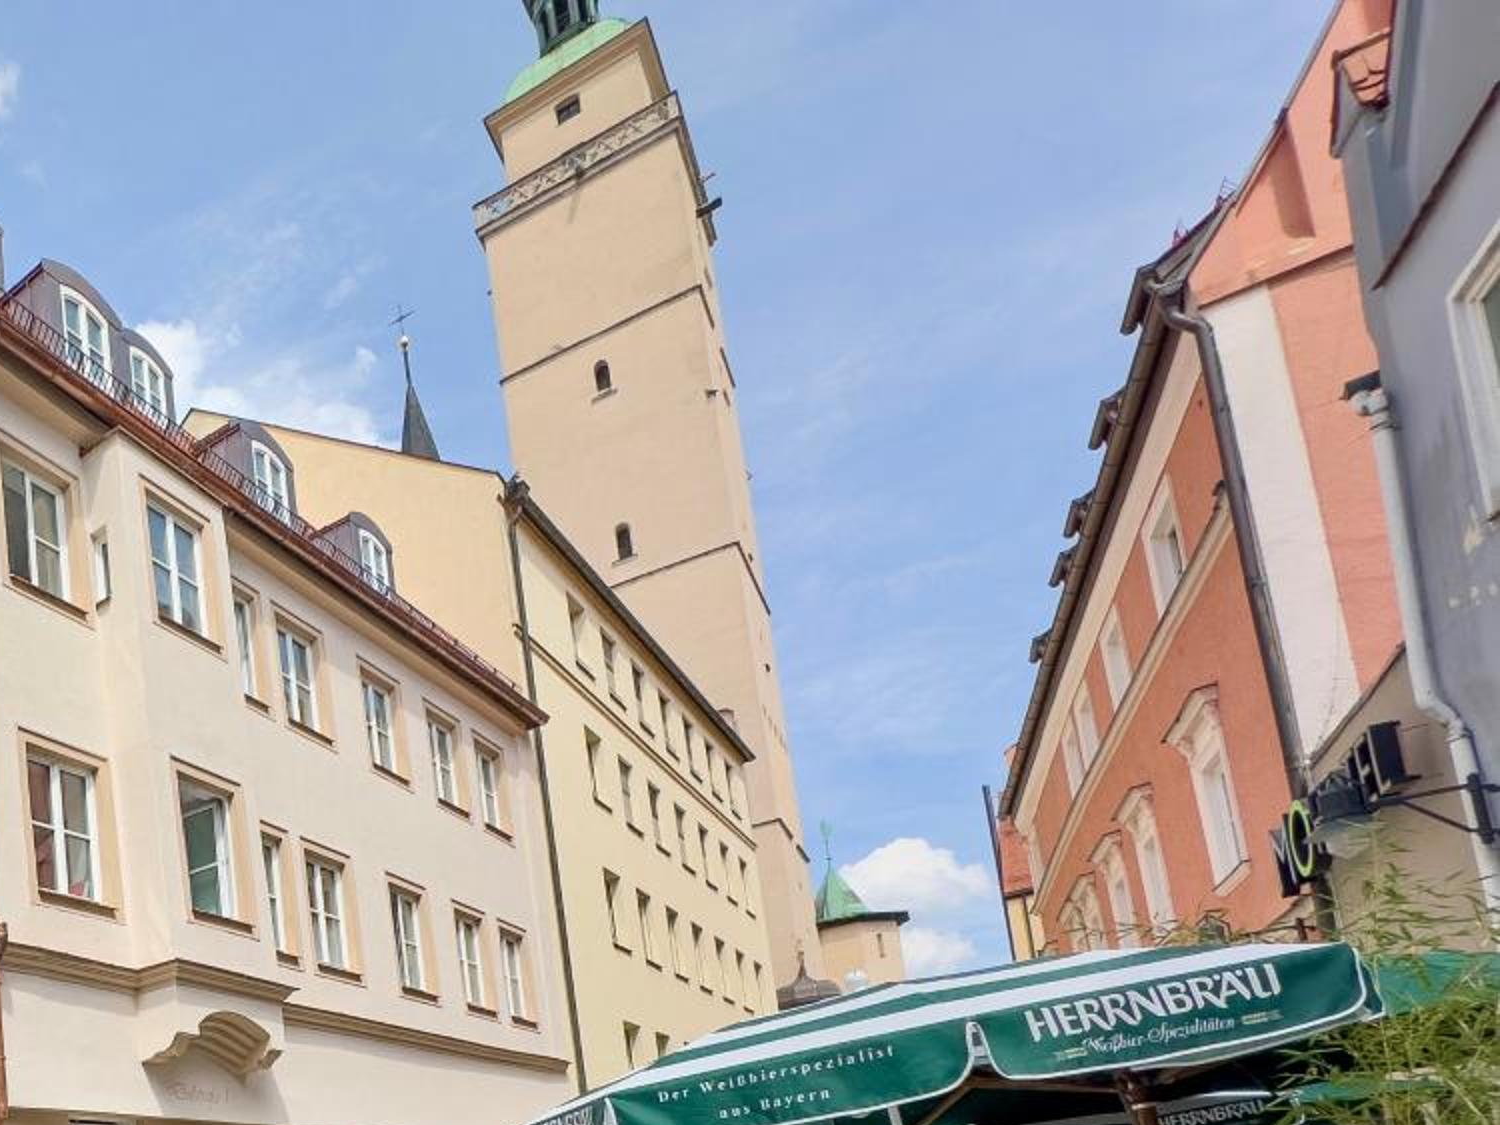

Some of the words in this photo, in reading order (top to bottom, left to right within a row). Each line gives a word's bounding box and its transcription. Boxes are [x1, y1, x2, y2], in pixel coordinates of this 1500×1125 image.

[1023, 962, 1283, 1043] HERRNBRÄU
[657, 1087, 690, 1103] Der
[699, 1045, 894, 1094] Weißbierspezialist
[718, 1107, 751, 1120] aus
[760, 1089, 831, 1112] Bayern
